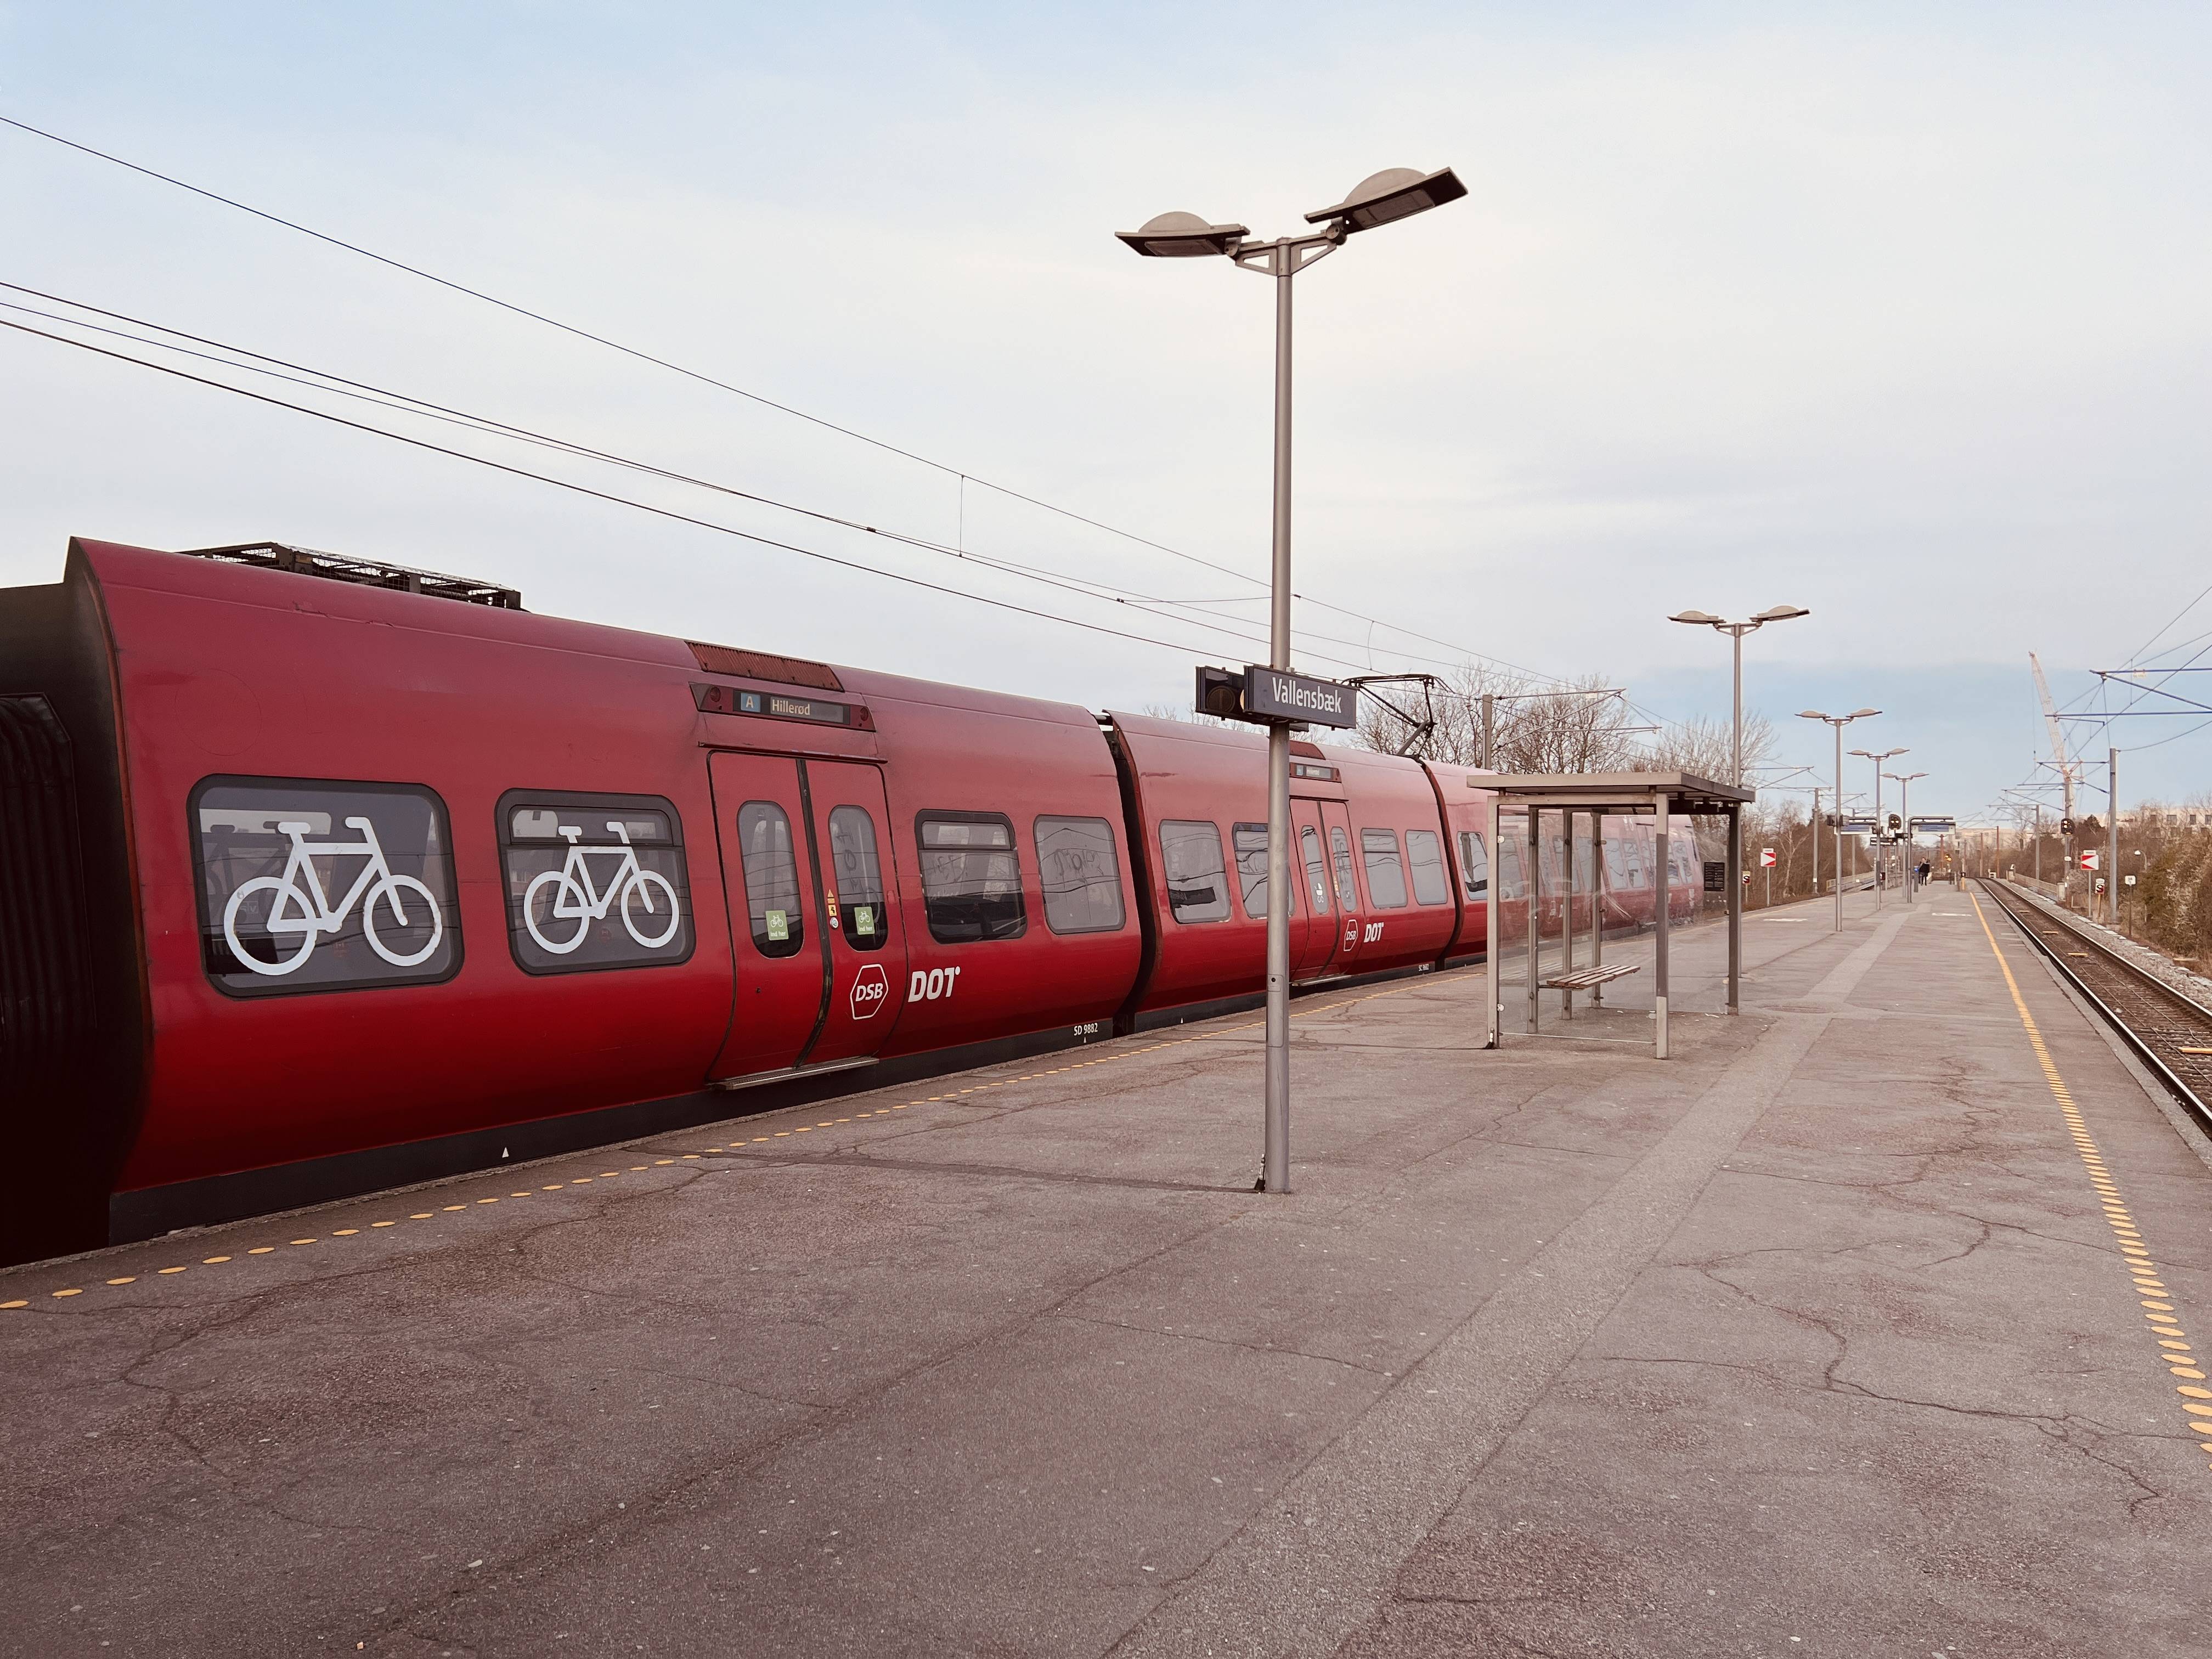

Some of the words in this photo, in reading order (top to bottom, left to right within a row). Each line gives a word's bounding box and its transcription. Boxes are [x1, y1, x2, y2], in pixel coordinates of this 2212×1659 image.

[1272, 677, 1342, 713] Vallensbæk
[746, 696, 754, 709] A
[772, 699, 810, 715] Hillerød
[1346, 930, 1357, 941] DSB
[1363, 922, 1384, 943] DOT
[855, 983, 883, 1002] DSB
[908, 966, 959, 1002] DOT
[1074, 1025, 1082, 1036] SD
[1084, 1023, 1098, 1034] 9882
